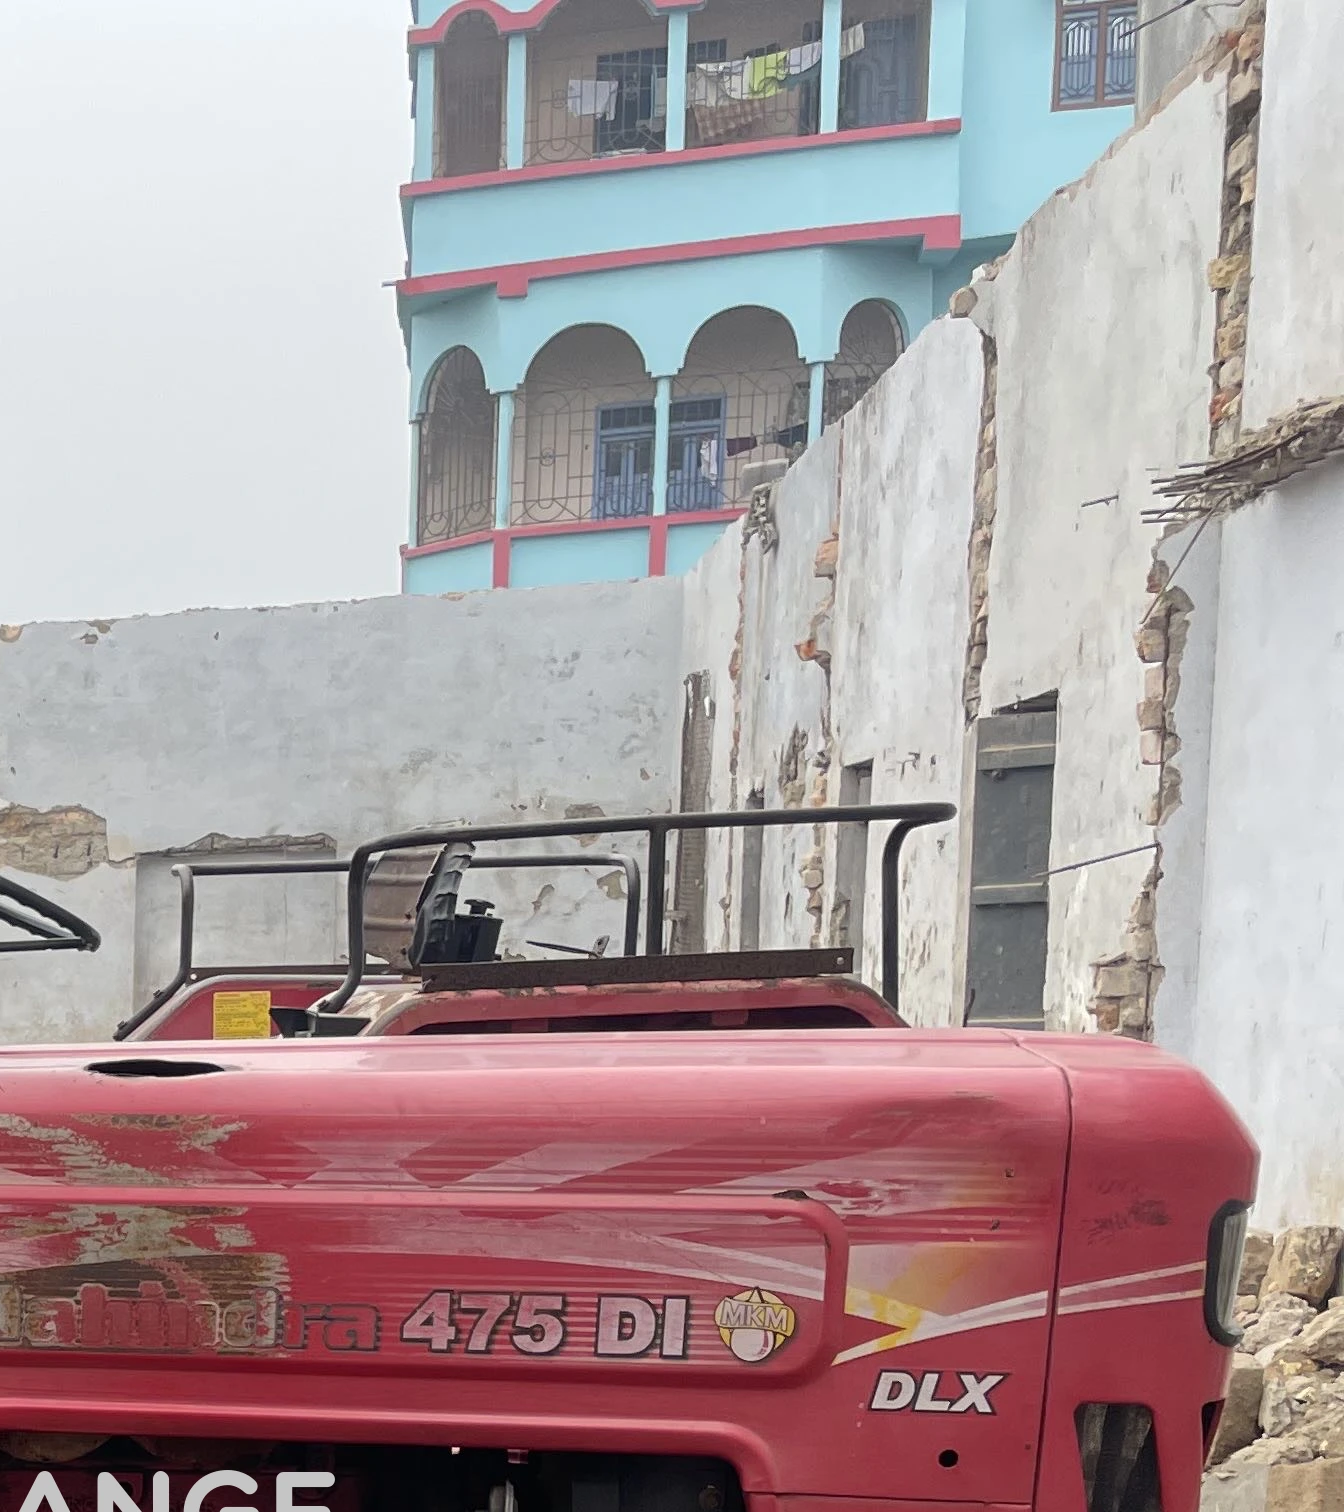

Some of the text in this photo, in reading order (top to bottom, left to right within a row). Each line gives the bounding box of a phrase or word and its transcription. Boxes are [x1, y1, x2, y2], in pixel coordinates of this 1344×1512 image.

[400, 1289, 569, 1356] 475
[594, 1293, 690, 1359] DI
[719, 1300, 791, 1333] MKM
[867, 1369, 1010, 1416] DLX
